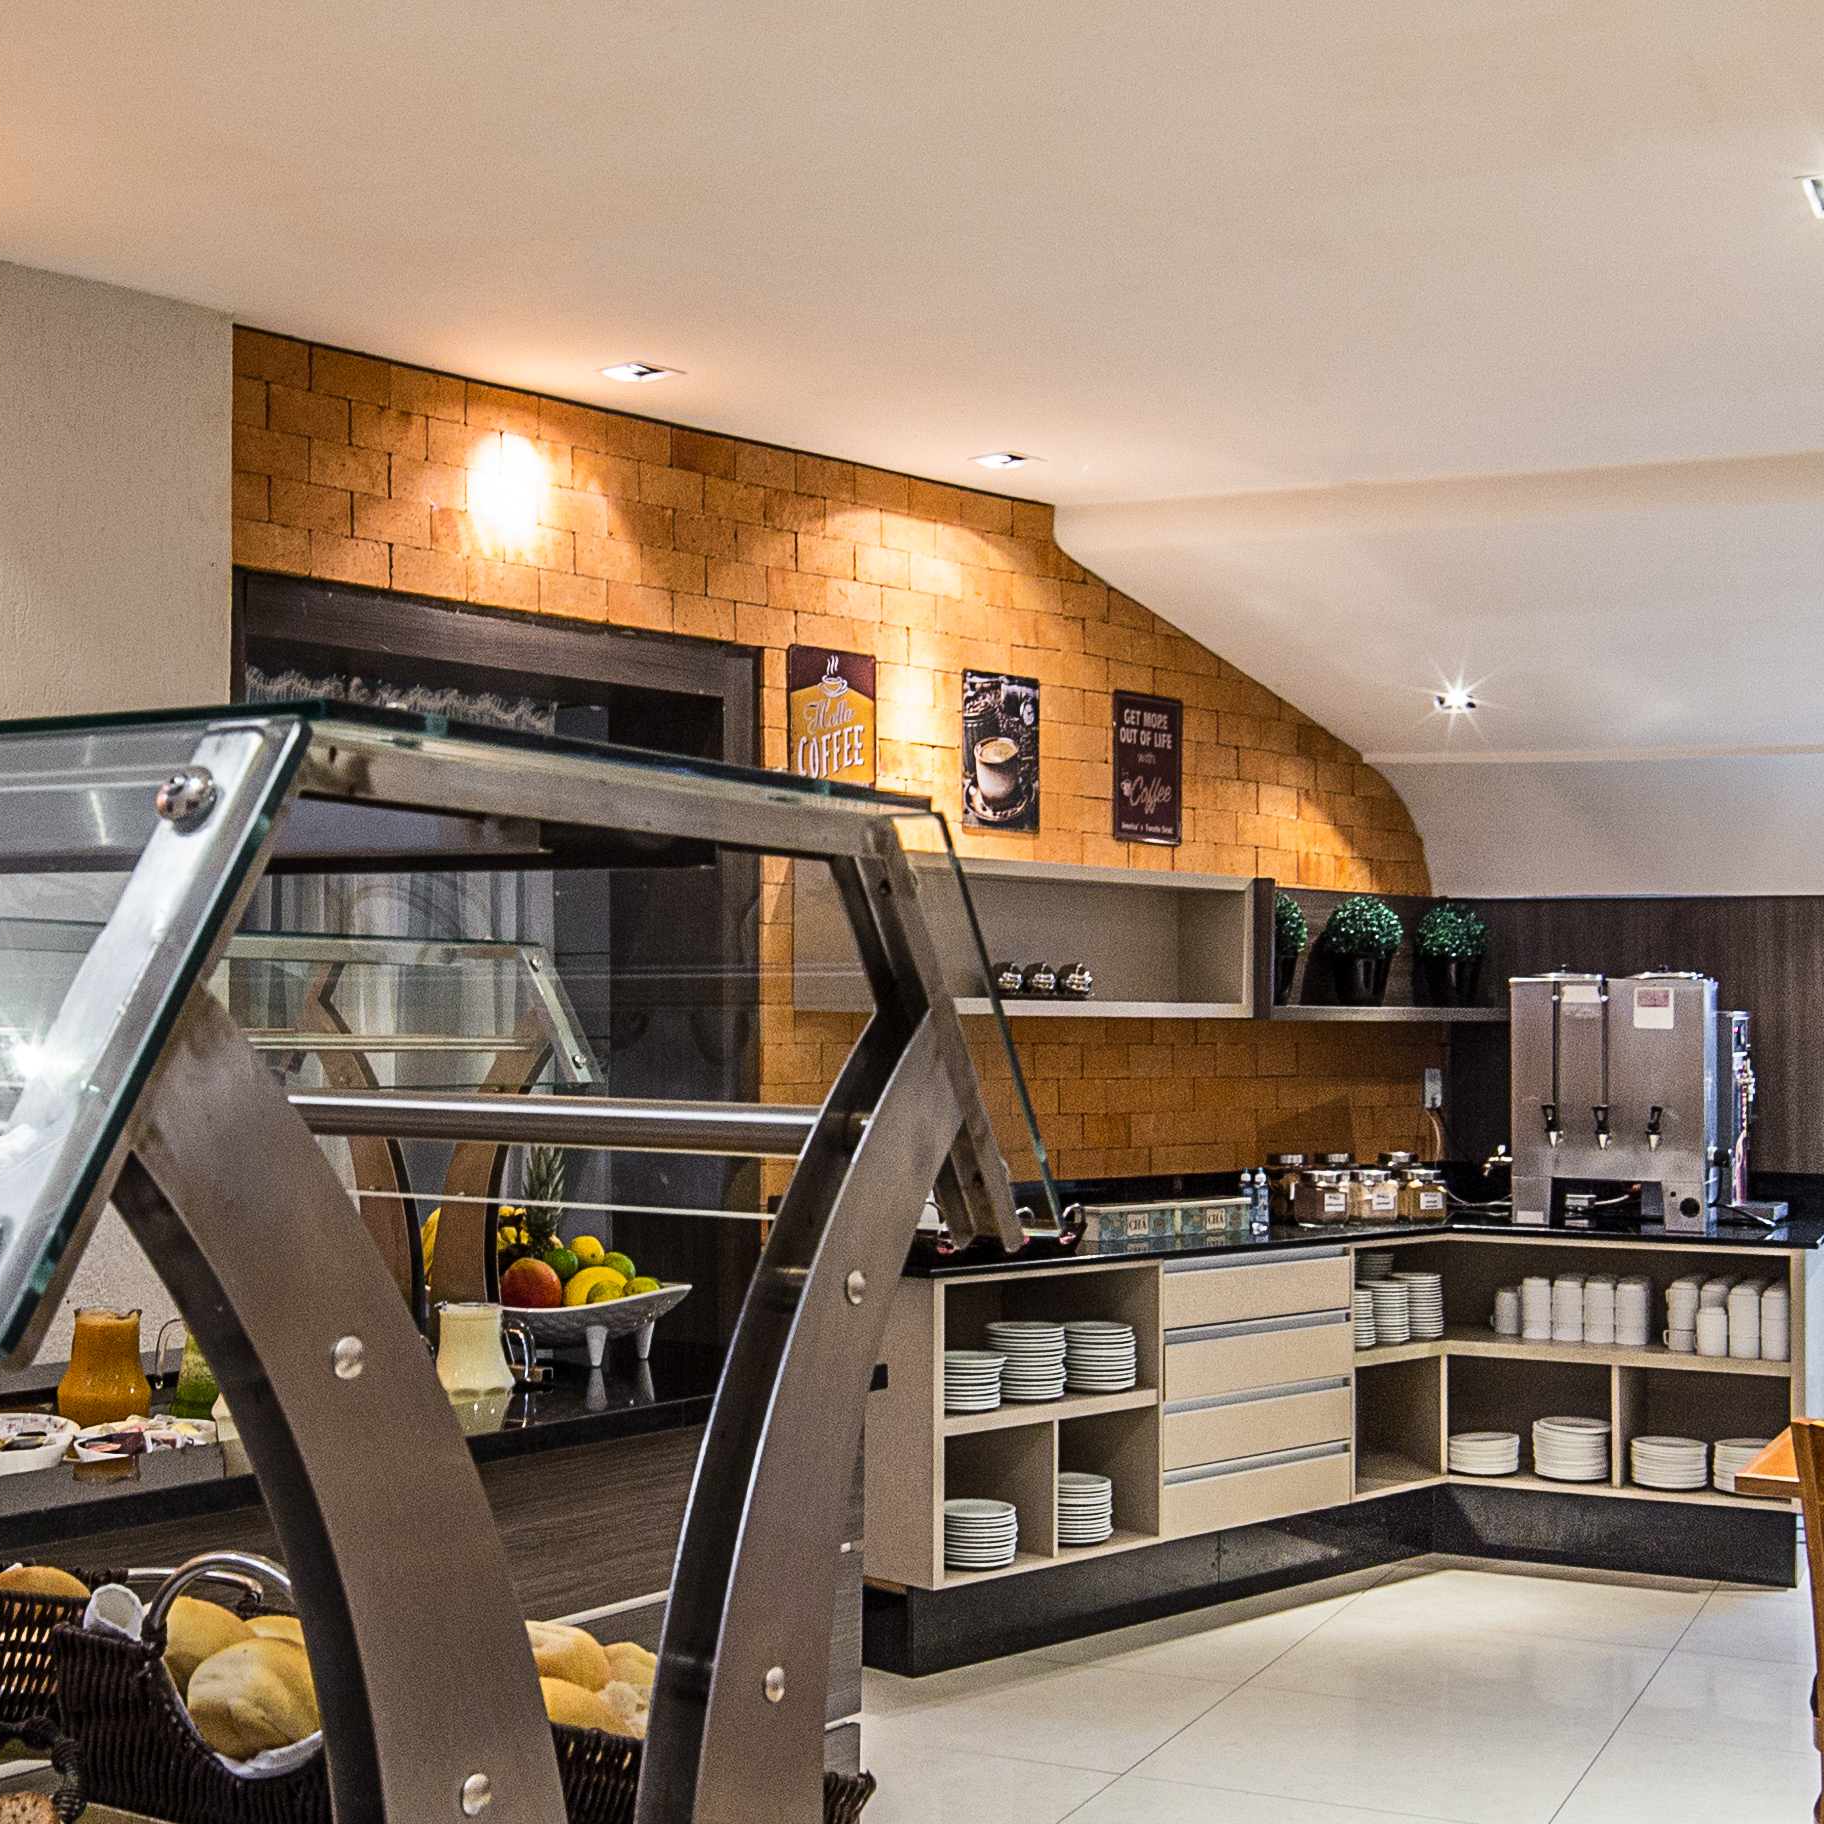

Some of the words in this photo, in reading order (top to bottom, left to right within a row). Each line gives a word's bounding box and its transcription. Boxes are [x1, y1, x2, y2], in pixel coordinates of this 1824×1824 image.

[803, 698, 854, 734] Hello
[1124, 708, 1141, 726] GET
[1143, 711, 1168, 730] MORE
[1120, 727, 1138, 745] OUT
[1140, 730, 1151, 746] OF
[1154, 732, 1172, 750] LIFE
[798, 725, 865, 779] COFFEE
[1137, 752, 1156, 765] with
[1130, 776, 1172, 814] Coffee
[1129, 1216, 1147, 1231] CHÁ
[1208, 1210, 1226, 1226] CHÁ
